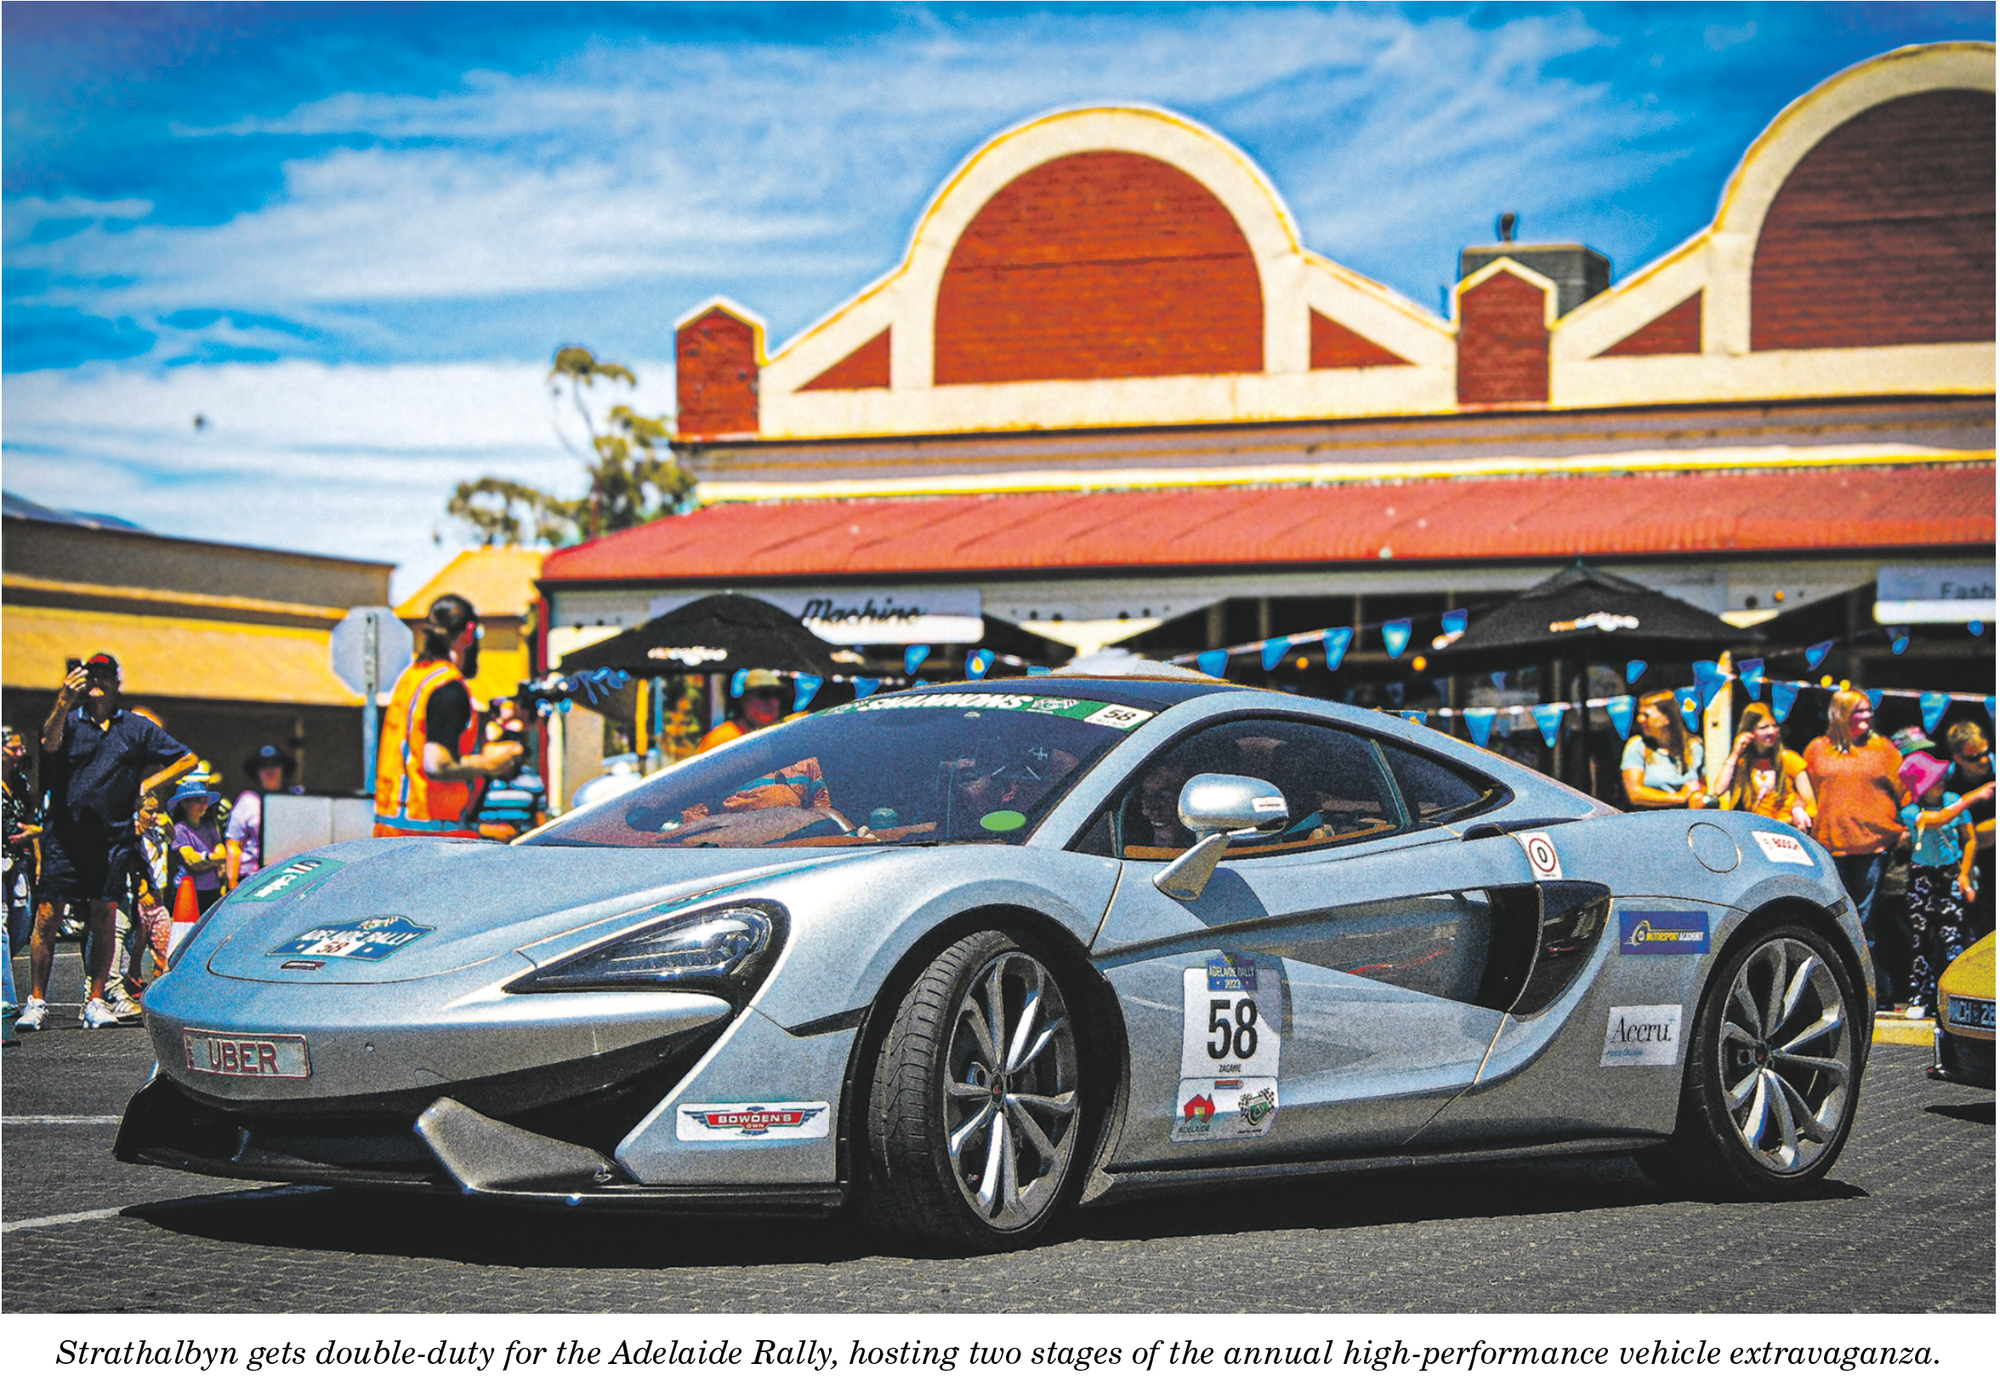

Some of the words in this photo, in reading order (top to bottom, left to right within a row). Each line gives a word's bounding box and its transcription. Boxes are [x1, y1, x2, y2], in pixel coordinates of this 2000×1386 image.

[1103, 709, 1137, 721] 58
[1536, 846, 1548, 863] 0
[363, 931, 421, 946] RALLY
[316, 941, 351, 954] 58
[1209, 965, 1237, 978] ADELAIDE
[1237, 965, 1255, 978] RALLY
[1224, 979, 1241, 989] 2023
[1207, 998, 1258, 1060] 58
[1611, 1016, 1672, 1043] Accru
[208, 1037, 279, 1074] UBER
[718, 1113, 792, 1124] BOWDEN'S
